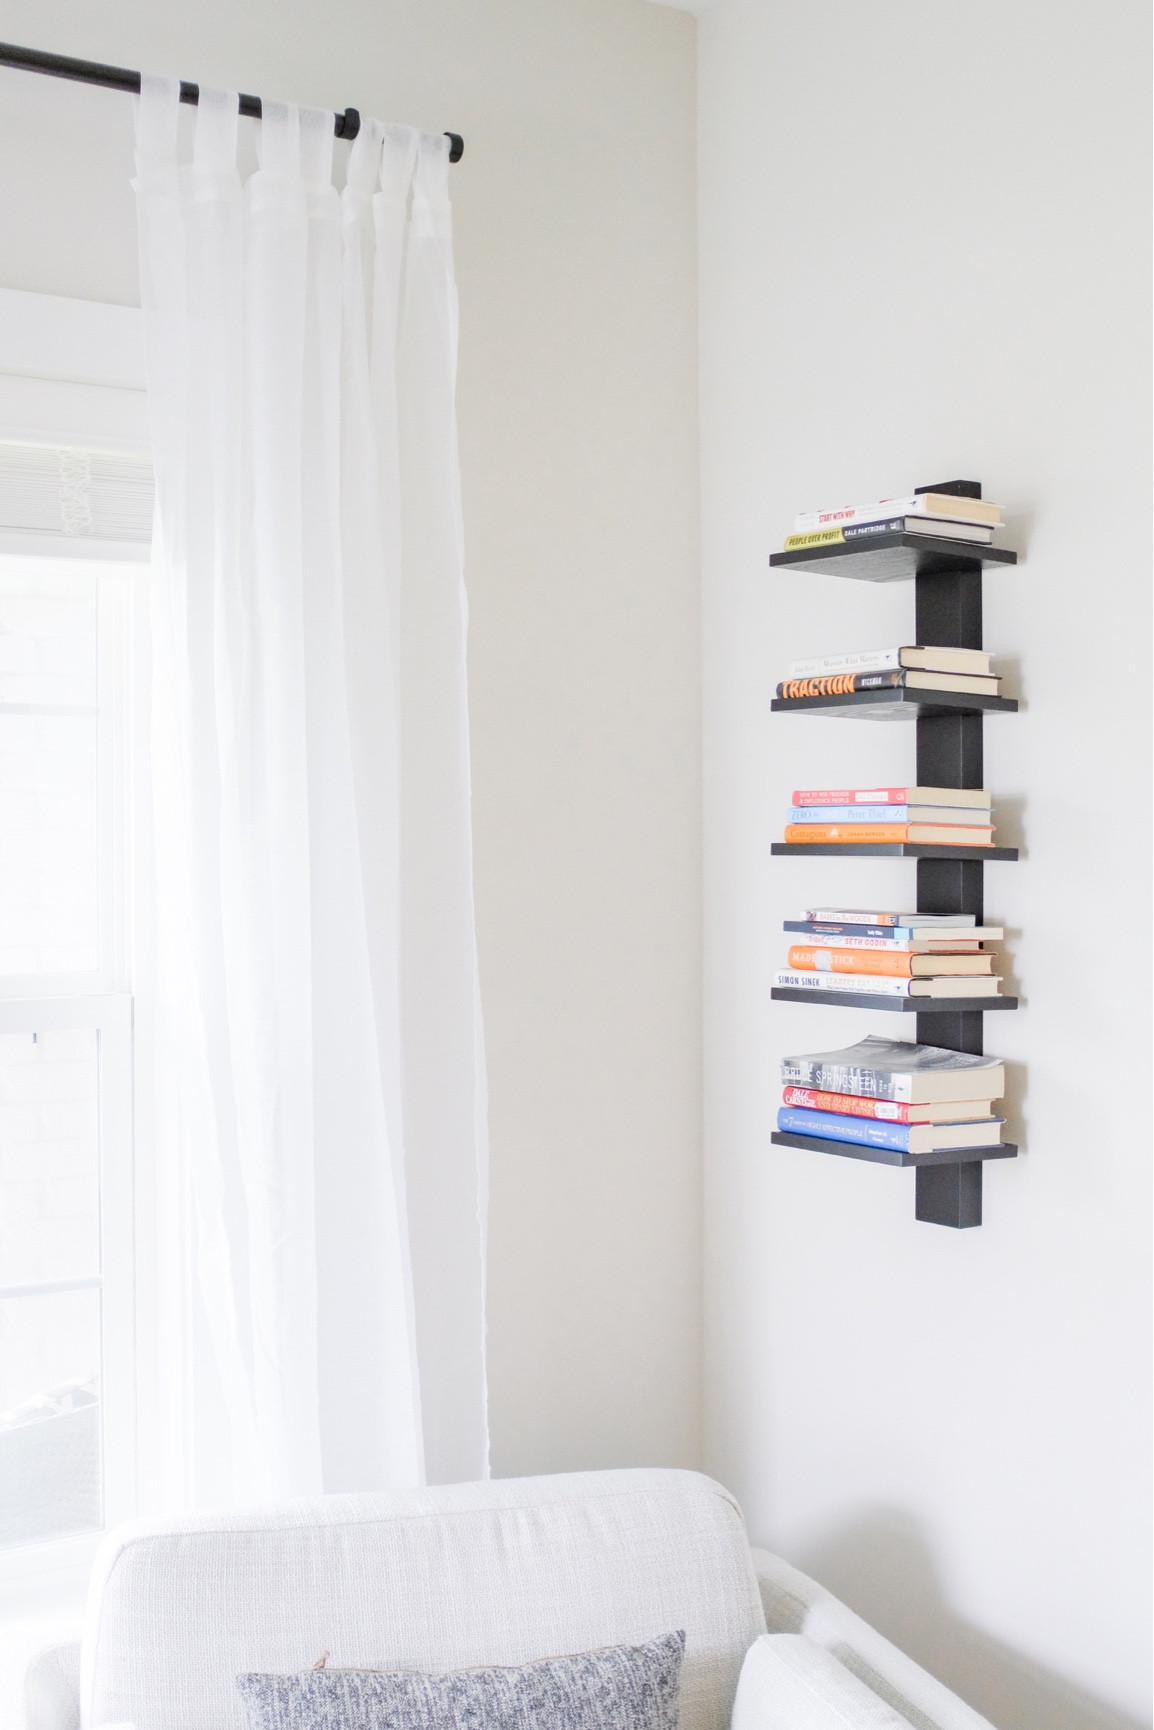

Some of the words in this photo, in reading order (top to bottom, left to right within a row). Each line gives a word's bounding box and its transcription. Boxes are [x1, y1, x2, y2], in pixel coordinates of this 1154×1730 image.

[818, 513, 833, 523] START
[833, 511, 845, 521] WITH
[845, 509, 856, 519] WHY
[844, 528, 857, 537] DALE
[858, 524, 886, 534] PARTRIDGE
[788, 535, 807, 546] PEOPLE
[807, 533, 821, 543] OVER
[821, 530, 840, 541] PROFIT
[782, 674, 856, 699] TRACTION
[791, 810, 812, 820] ZERO
[847, 810, 865, 819] Peter
[790, 828, 826, 841] Contagious
[844, 937, 863, 945] SETH
[864, 939, 887, 947] GODIN
[792, 952, 816, 963] MADE
[830, 954, 855, 965] STICK
[778, 975, 799, 985] SIMON
[802, 977, 820, 986] SINEK
[784, 1066, 813, 1082] BRUCE
[816, 1070, 876, 1092] SPRINGSTEEN
[792, 1088, 809, 1097] DALE
[788, 1116, 794, 1127] 7
